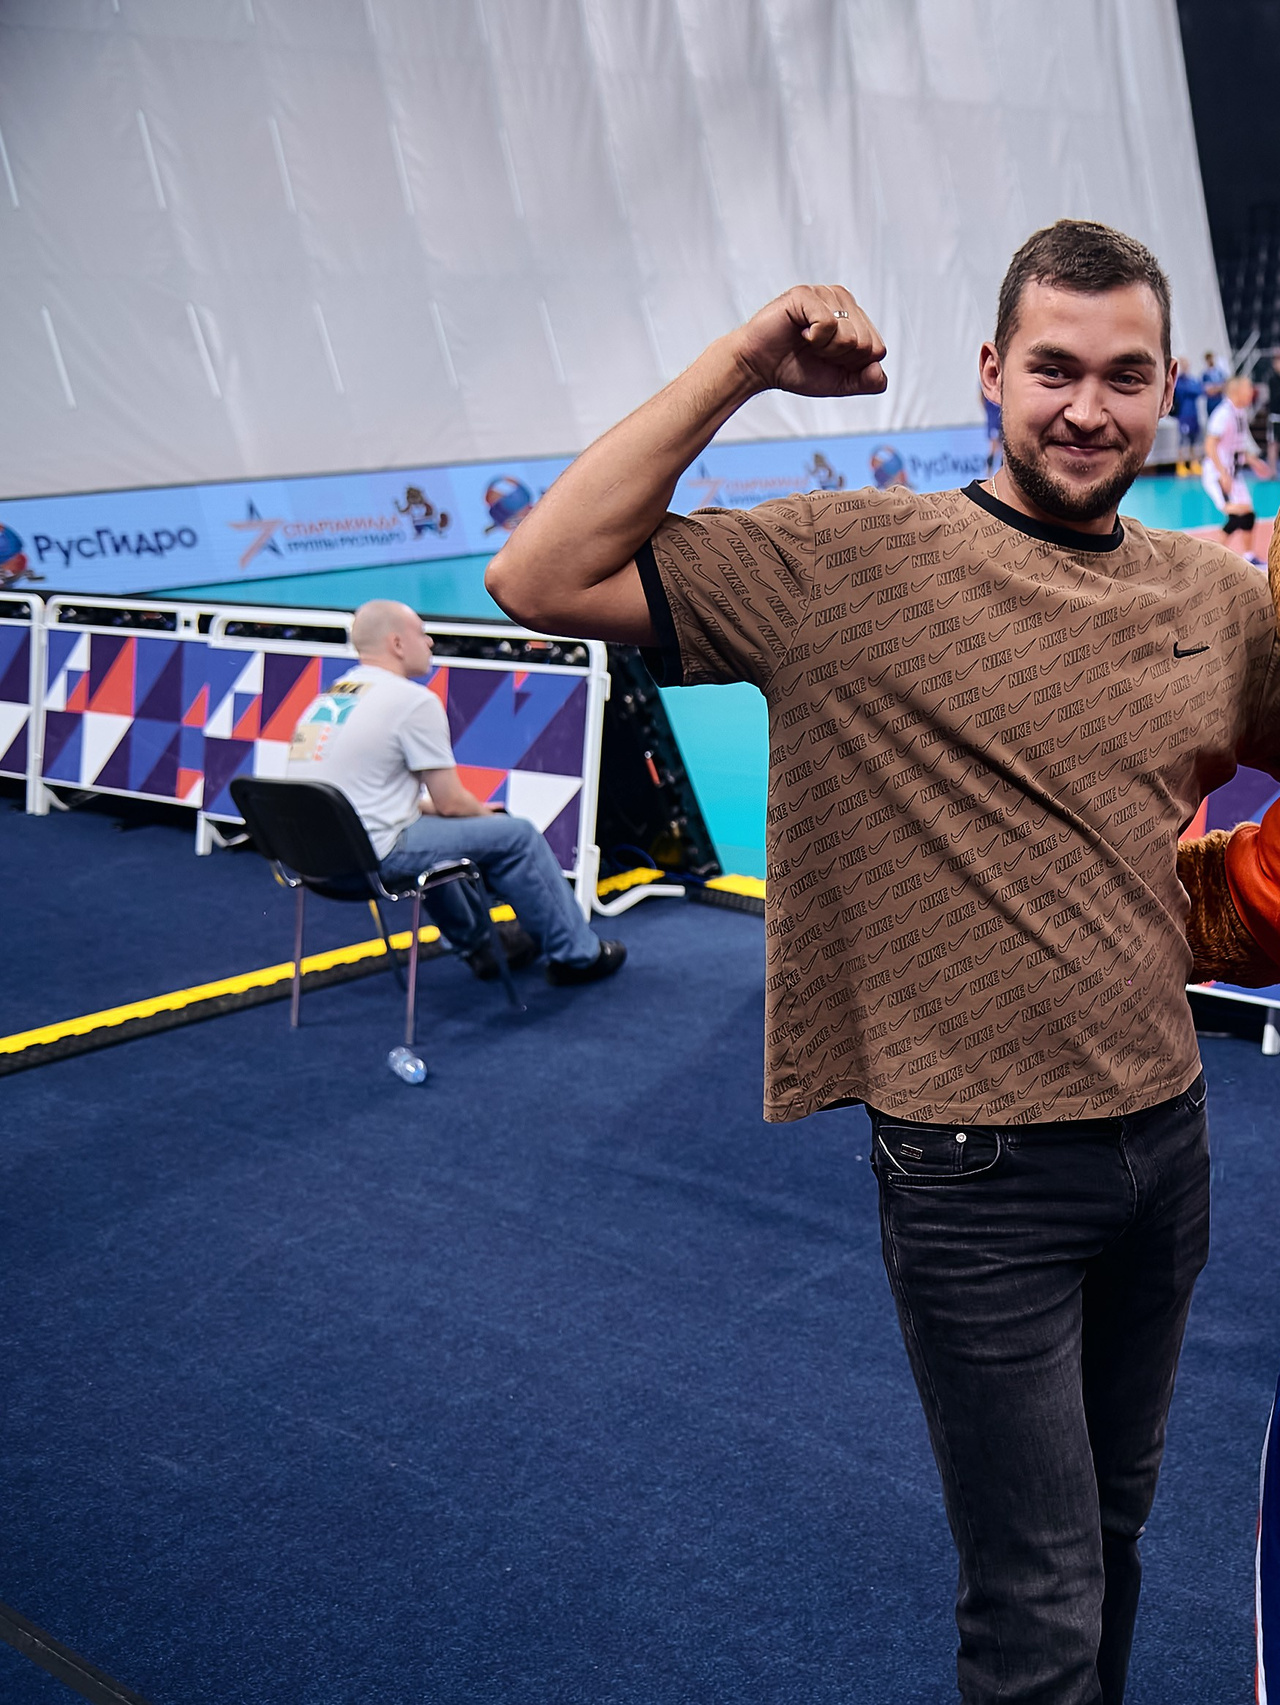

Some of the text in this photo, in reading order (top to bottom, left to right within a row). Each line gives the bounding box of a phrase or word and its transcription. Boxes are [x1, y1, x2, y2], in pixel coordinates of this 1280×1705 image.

[835, 498, 865, 514] NIKE
[861, 514, 891, 531] NIKE
[33, 526, 198, 568] РусГидро
[662, 557, 691, 588] NIKE
[668, 534, 699, 562] NIKE
[709, 591, 741, 623] NIKE
[727, 537, 798, 628] NIKE NIKE
[775, 569, 803, 598] NIKE
[826, 532, 916, 569] NIKE NIKE
[851, 551, 940, 588] NIKE NIKE
[1216, 573, 1239, 594] NIKE
[719, 564, 788, 658] NIKE NIKE
[815, 567, 965, 627] NIKE NIKE NIKE
[841, 581, 992, 645] NIKE NIKE NIKE
[1238, 587, 1259, 607] NIKE
[780, 613, 1042, 729] NIKE NIKE NIKE NIKE NIKE
[806, 597, 1017, 686] NIKE NIKE NIKE NIKE
[808, 607, 1118, 744] NIKE NIKE NIKE NIKE NIKE NIKE
[785, 625, 1135, 787] NIKE NIKE NIKE NIKE NIKE NIKE NIKE
[975, 642, 1154, 729] NIKE NIKE NIKE NIKE
[1001, 659, 1171, 746] NIKE NIKE NIKE NIKE
[1026, 693, 1153, 762] NIKE NIKE NIKE
[1050, 711, 1172, 779] NIKE NIKE NIKE
[1072, 728, 1188, 796] NIKE NIKE NIKE
[786, 764, 922, 843] NIKE NIKE NIKE
[811, 750, 895, 801] NIKE NIKE
[1093, 788, 1116, 812] NIKE
[789, 794, 977, 898] NIKE NIKE NIKE NIKE
[813, 779, 950, 856] NIKE NIKE NIKE
[1113, 802, 1137, 827] NIKE
[1134, 817, 1155, 842] NIKE
[794, 924, 822, 953] NIKE
[841, 902, 867, 925] NIKE
[892, 874, 922, 900] NIKE
[947, 849, 976, 873] NIKE
[1002, 822, 1031, 847] NIKE
[817, 808, 1004, 908] NIKE NIKE NIKE NIKE
[800, 976, 826, 1005] NIKE
[845, 955, 866, 975] NIKE
[890, 929, 920, 954] NIKE
[946, 902, 976, 927] NIKE
[1000, 877, 1029, 902] NIKE
[1055, 847, 1082, 875] NIKE
[822, 834, 1058, 960] NIKE NIKE NIKE NIKE NIKE
[825, 859, 1104, 1011] NIKE NIKE NIKE NIKE NIKE NIKE
[887, 984, 916, 1008] NIKE
[943, 957, 973, 982] NIKE
[1000, 930, 1029, 955] NIKE
[1053, 903, 1082, 929] NIKE
[913, 944, 1056, 1022] NIKE NIKE NIKE
[939, 1012, 968, 1037] NIKE
[996, 985, 1025, 1010] NIKE
[1052, 957, 1082, 983] NIKE
[805, 1025, 830, 1057] NIKE
[830, 1037, 857, 1061] NIKE
[908, 969, 1103, 1076] NIKE NIKE NIKE NIKE
[933, 979, 1123, 1090] NIKE NIKE NIKE NIKE
[959, 989, 1142, 1103] NIKE NIKE NIKE NIKE
[986, 1092, 1015, 1117] NIKE
[1041, 1063, 1070, 1087] NIKE
[1014, 1103, 1042, 1126] NIKE
[1066, 1074, 1095, 1099] NIKE
[1091, 1084, 1119, 1110] NIKE
